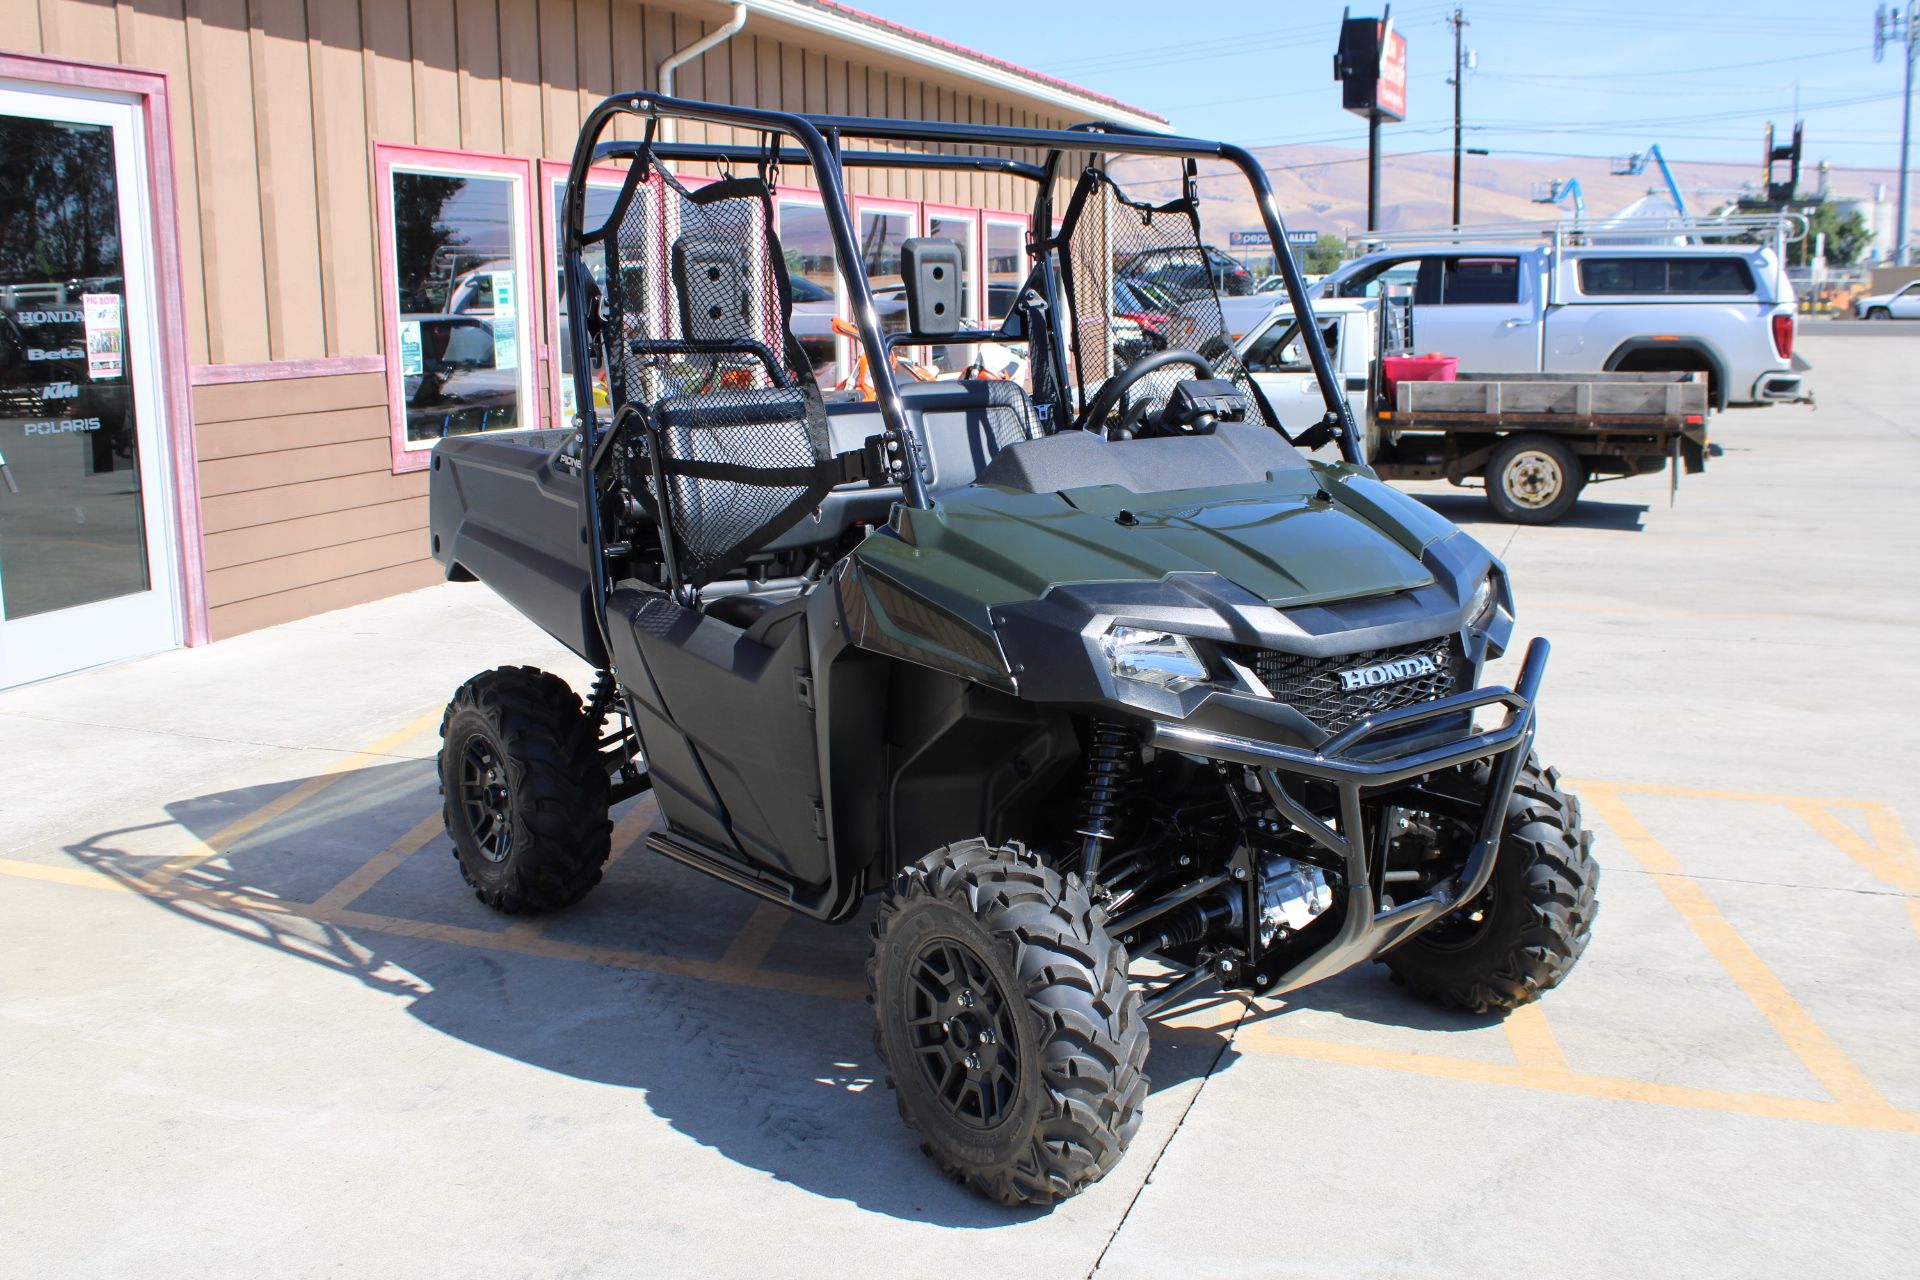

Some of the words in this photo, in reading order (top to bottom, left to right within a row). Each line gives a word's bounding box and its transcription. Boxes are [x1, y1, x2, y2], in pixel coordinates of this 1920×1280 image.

[1242, 233, 1270, 244] peps
[1289, 233, 1317, 242] ALLES
[86, 296, 97, 305] PIG
[99, 296, 118, 305] BOWL
[18, 310, 86, 324] HONDA
[28, 348, 85, 361] Beta
[42, 382, 80, 399] KTM
[24, 418, 101, 436] POLARIS
[560, 454, 582, 469] PIONE
[1338, 655, 1437, 692] HONDA
